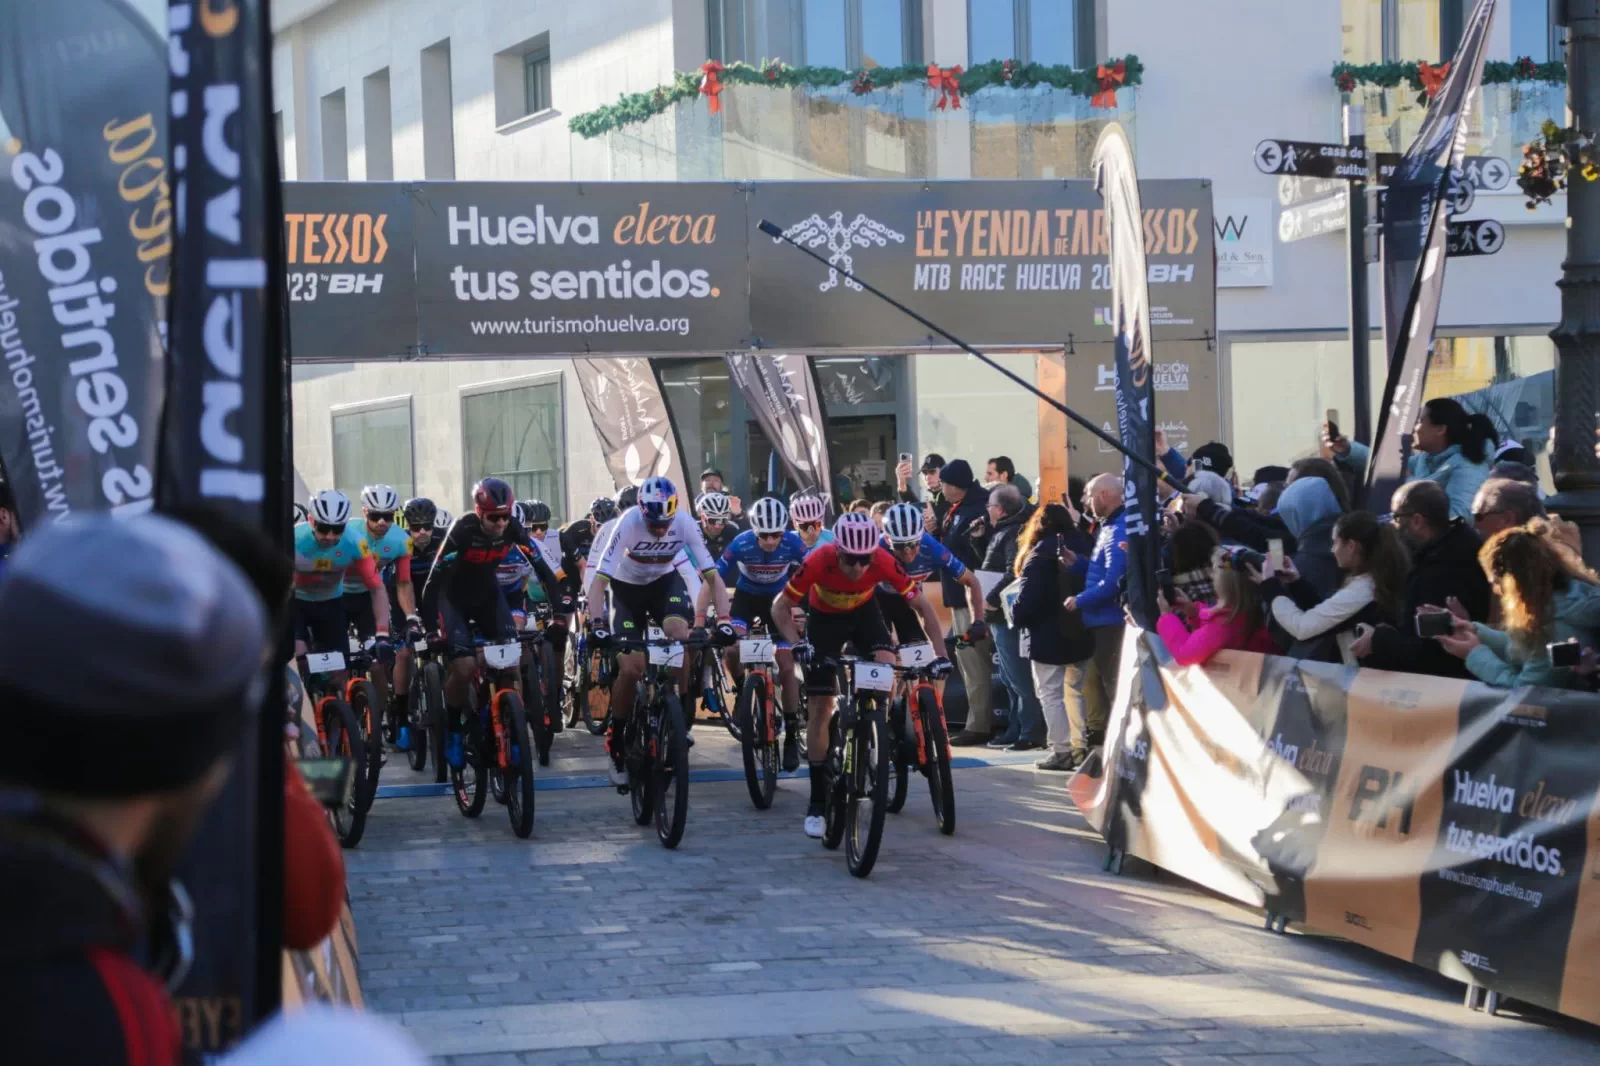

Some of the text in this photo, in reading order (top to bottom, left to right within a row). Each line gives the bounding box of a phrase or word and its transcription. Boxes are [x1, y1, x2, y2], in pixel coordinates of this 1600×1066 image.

[1335, 164, 1369, 176] cultur
[448, 202, 717, 246] Huelva eleva
[917, 211, 932, 229] LA
[285, 213, 388, 264] TESSOS
[915, 210, 1049, 257] LEYENDA
[1055, 208, 1199, 256] TARSSOS
[1054, 238, 1069, 256] DE
[450, 259, 721, 301] tus sentidos.
[914, 263, 1194, 290] MTB RACE HUELVA 20 BH
[287, 272, 318, 302] 23
[328, 273, 384, 294] BH
[470, 315, 691, 337] www.turismohuelva.org
[1154, 360, 1189, 373] ACIÓN
[1152, 373, 1189, 385] UELVA
[632, 540, 682, 551] DMT
[500, 649, 505, 658] 1
[752, 642, 761, 653] 7
[914, 649, 922, 661] 2
[321, 653, 329, 661] 3
[870, 668, 879, 679] 6
[1453, 769, 1516, 814] Huelva
